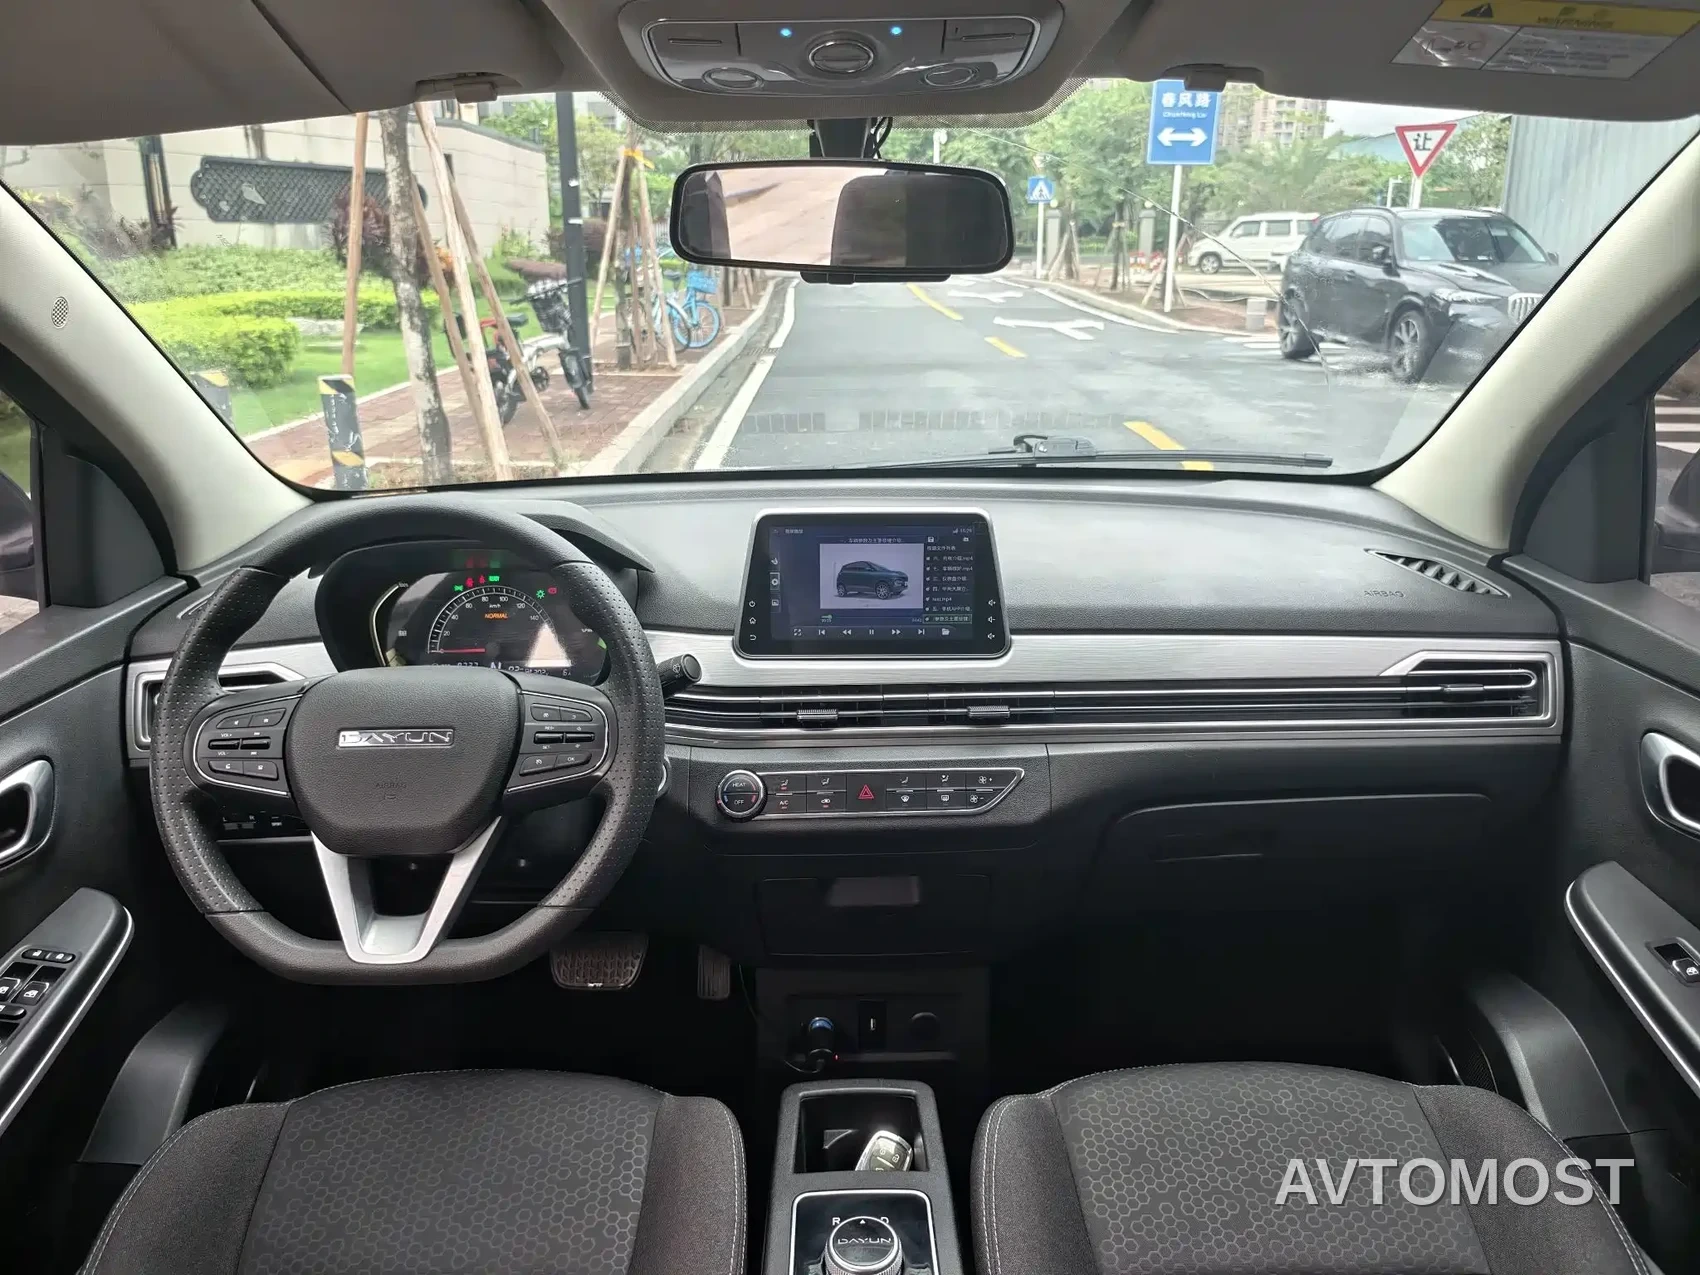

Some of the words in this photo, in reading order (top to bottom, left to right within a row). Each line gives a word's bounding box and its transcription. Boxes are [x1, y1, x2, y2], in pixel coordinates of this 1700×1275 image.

[1413, 133, 1432, 151] 让
[340, 731, 453, 743] DAYUN
[832, 1217, 841, 1226] R
[837, 1237, 892, 1245] DAYUN
